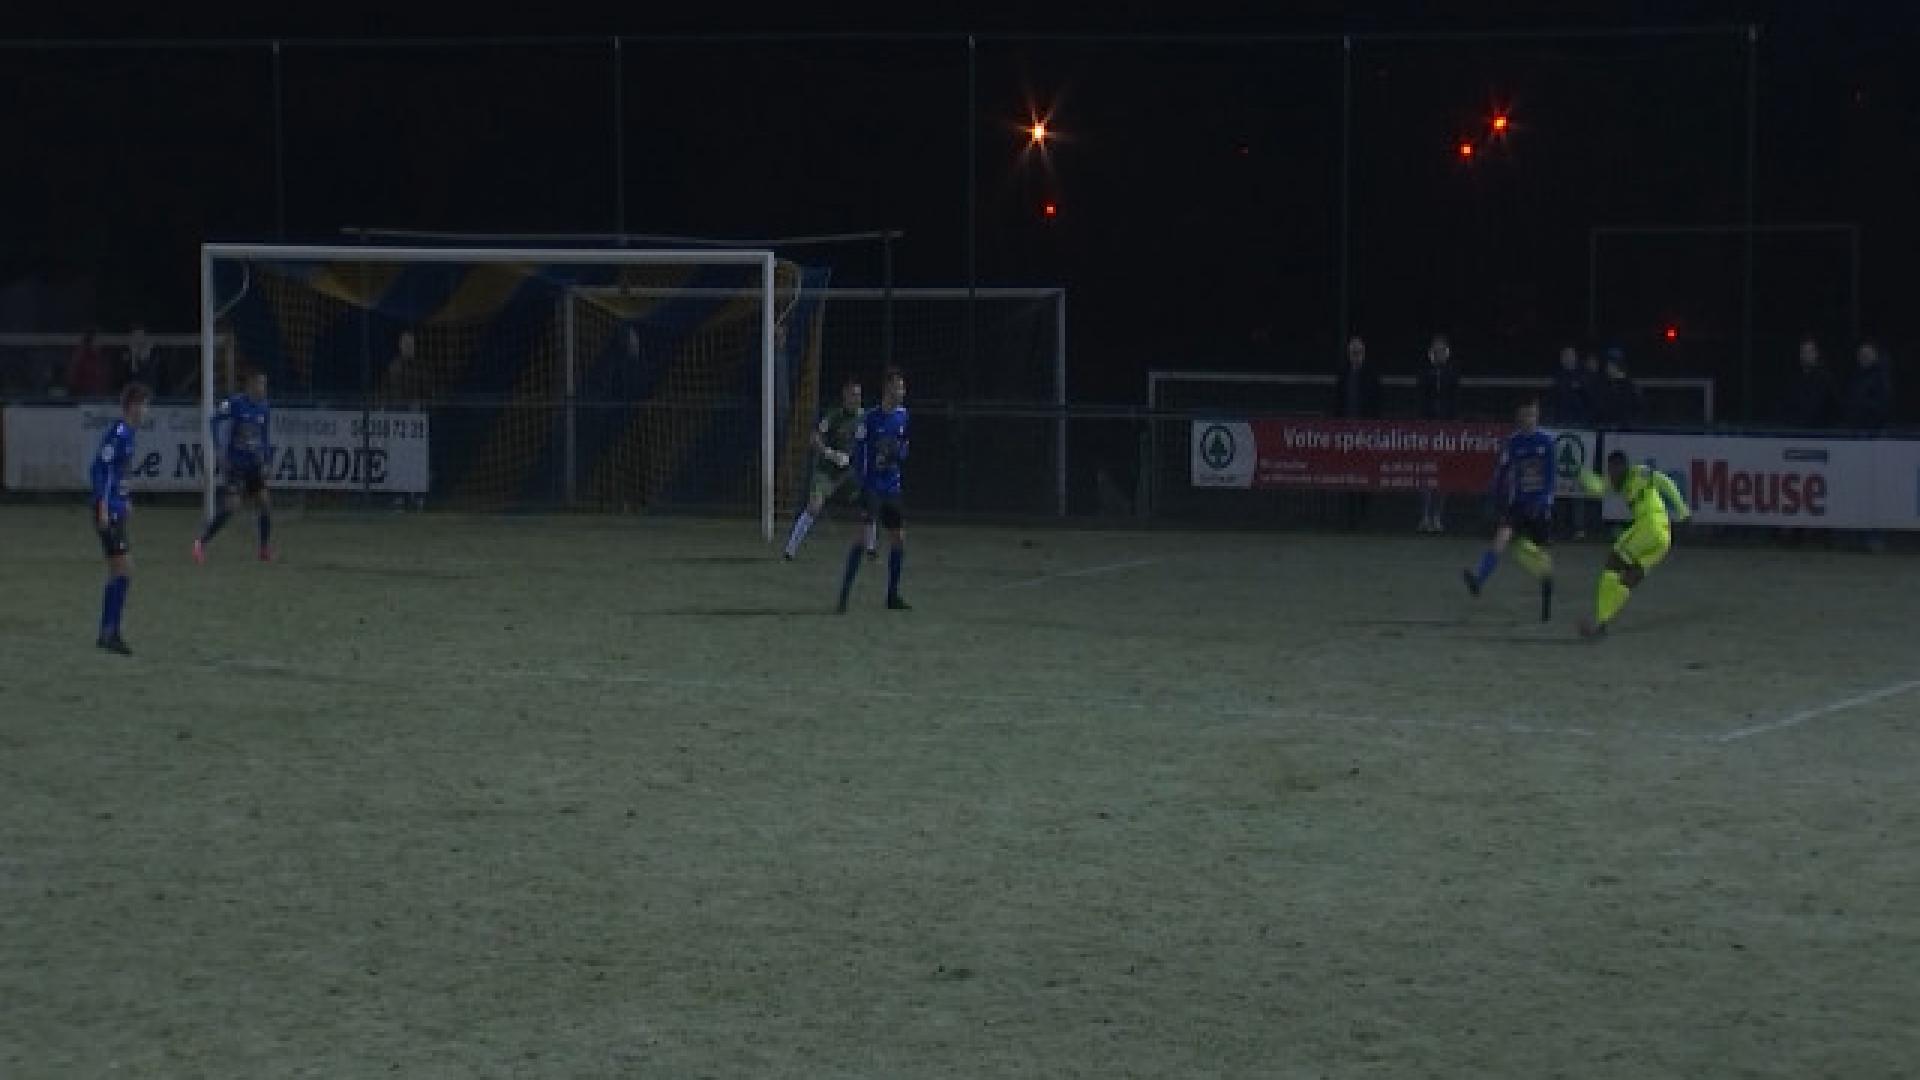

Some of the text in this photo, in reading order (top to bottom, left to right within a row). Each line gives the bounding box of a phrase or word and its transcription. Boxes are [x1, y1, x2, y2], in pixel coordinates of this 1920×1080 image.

[1283, 428, 1331, 448] Votre
[1334, 428, 1428, 454] spécialiste
[1432, 430, 1455, 451] du
[1690, 458, 1827, 517] Meuse
